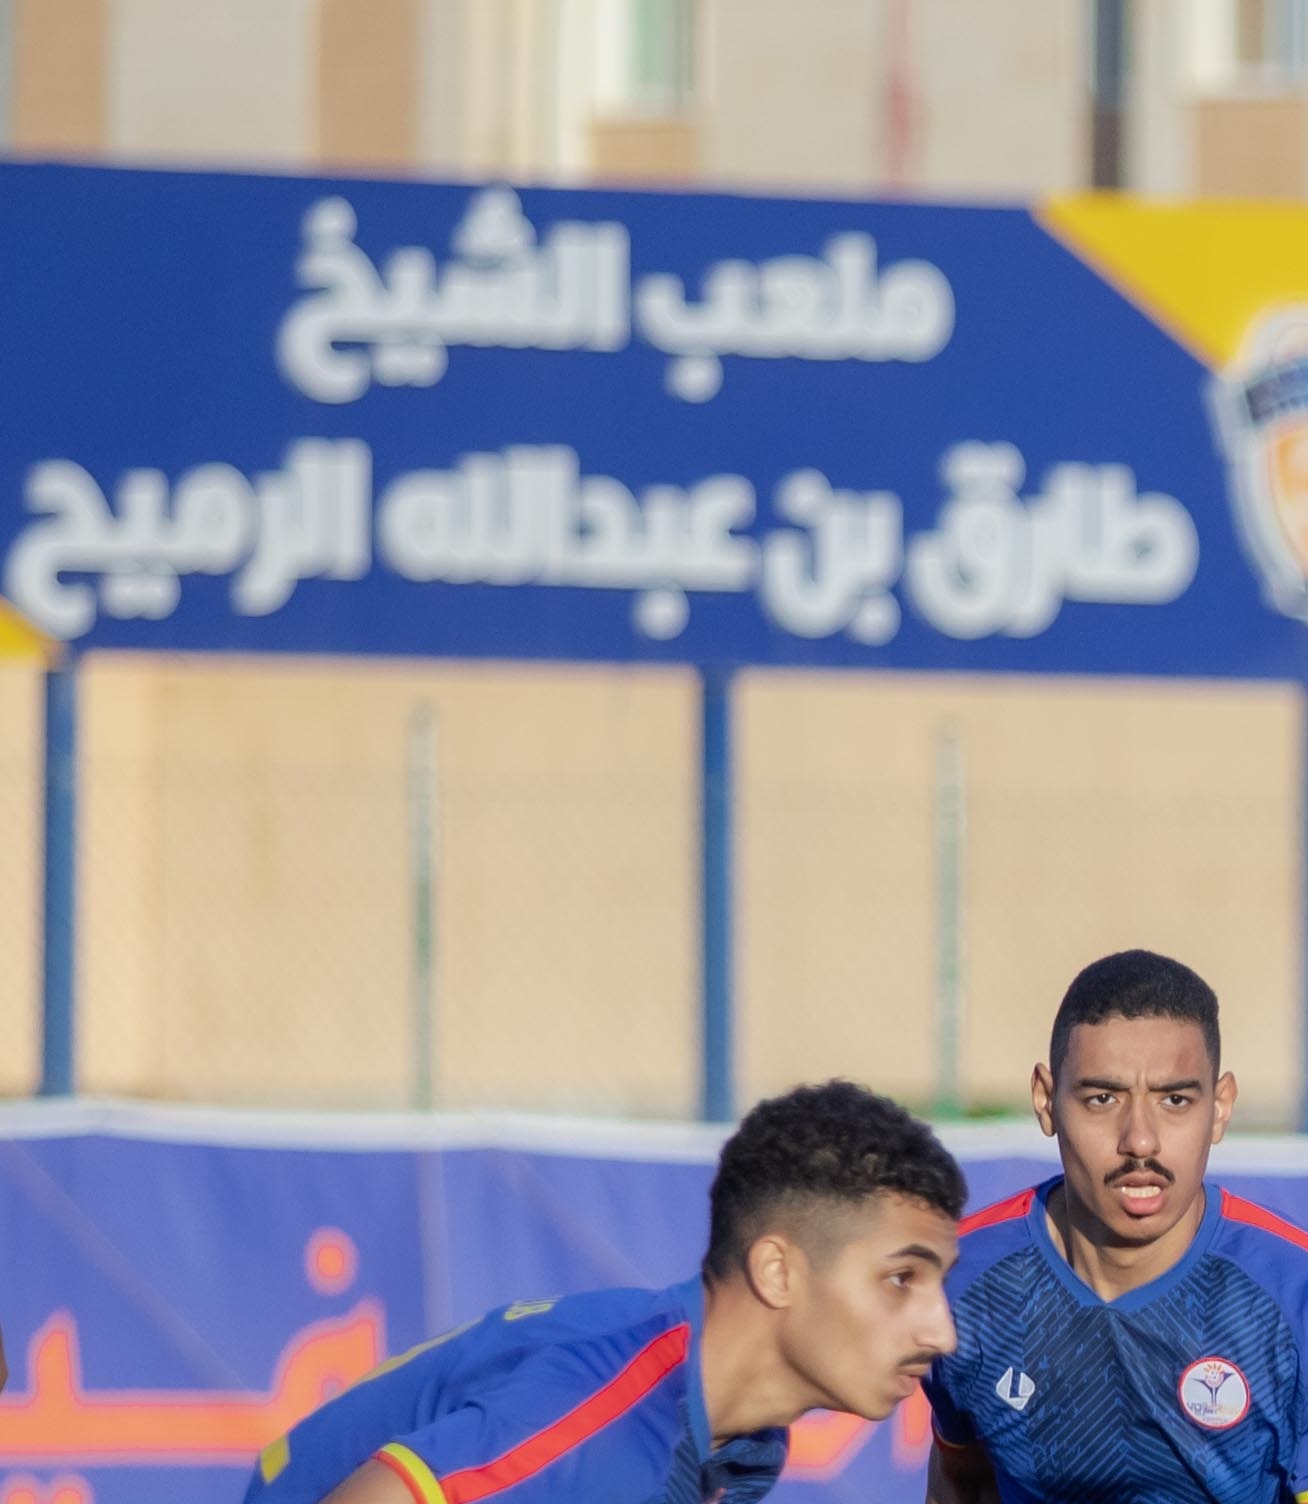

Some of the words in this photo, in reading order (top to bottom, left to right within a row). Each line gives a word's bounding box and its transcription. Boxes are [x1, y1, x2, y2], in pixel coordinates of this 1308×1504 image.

[277, 184, 631, 403] الشيخ
[635, 231, 955, 402] ملعب
[4, 437, 373, 640] الرميح
[376, 444, 758, 640] عبدالله
[761, 468, 902, 646] بن
[907, 440, 1198, 638] طارق
